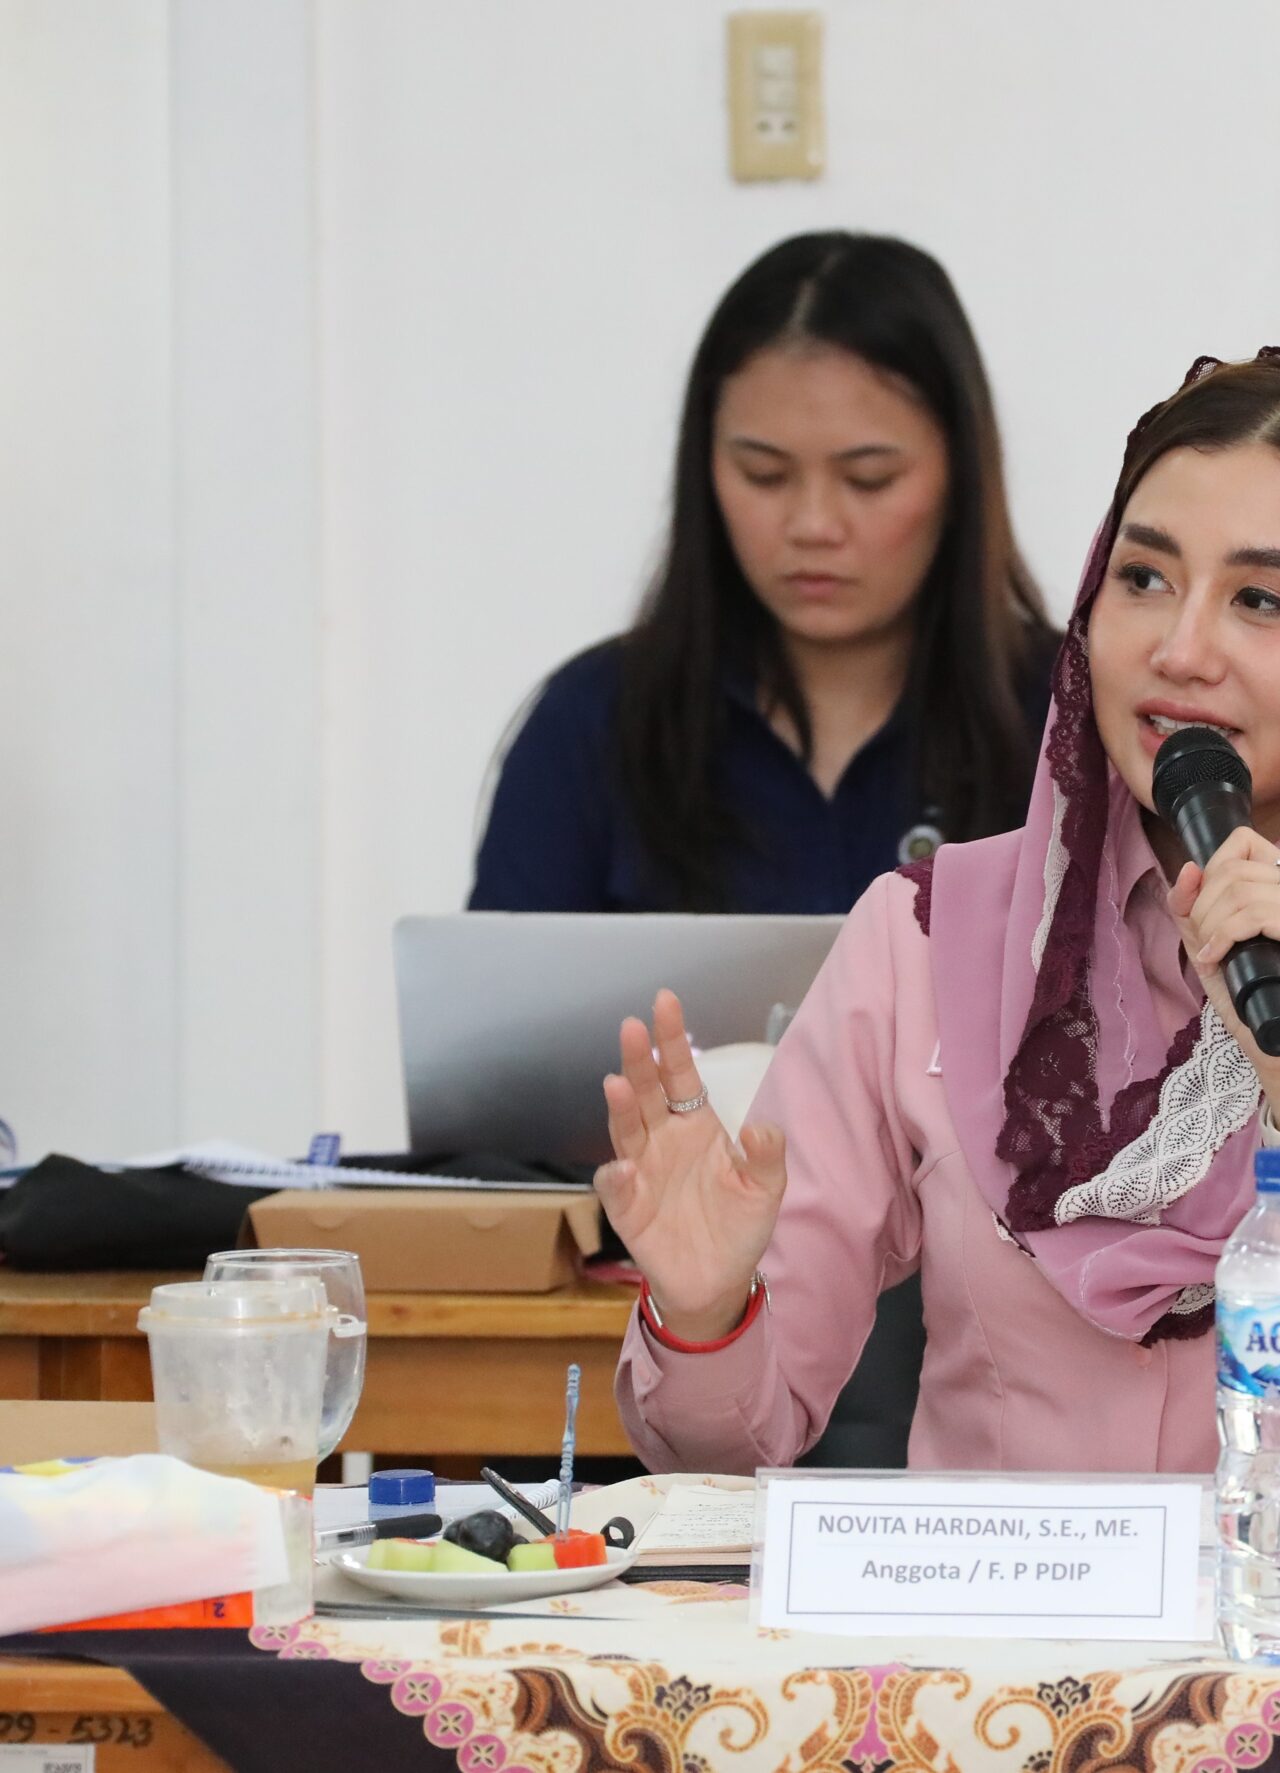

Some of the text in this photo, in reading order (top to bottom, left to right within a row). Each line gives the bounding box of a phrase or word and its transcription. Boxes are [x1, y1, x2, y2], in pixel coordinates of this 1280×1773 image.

[818, 1515, 1138, 1540] NOVITA HARDANI, S.E., ME.
[862, 1559, 1091, 1584] Anggota / F. P PDIP
